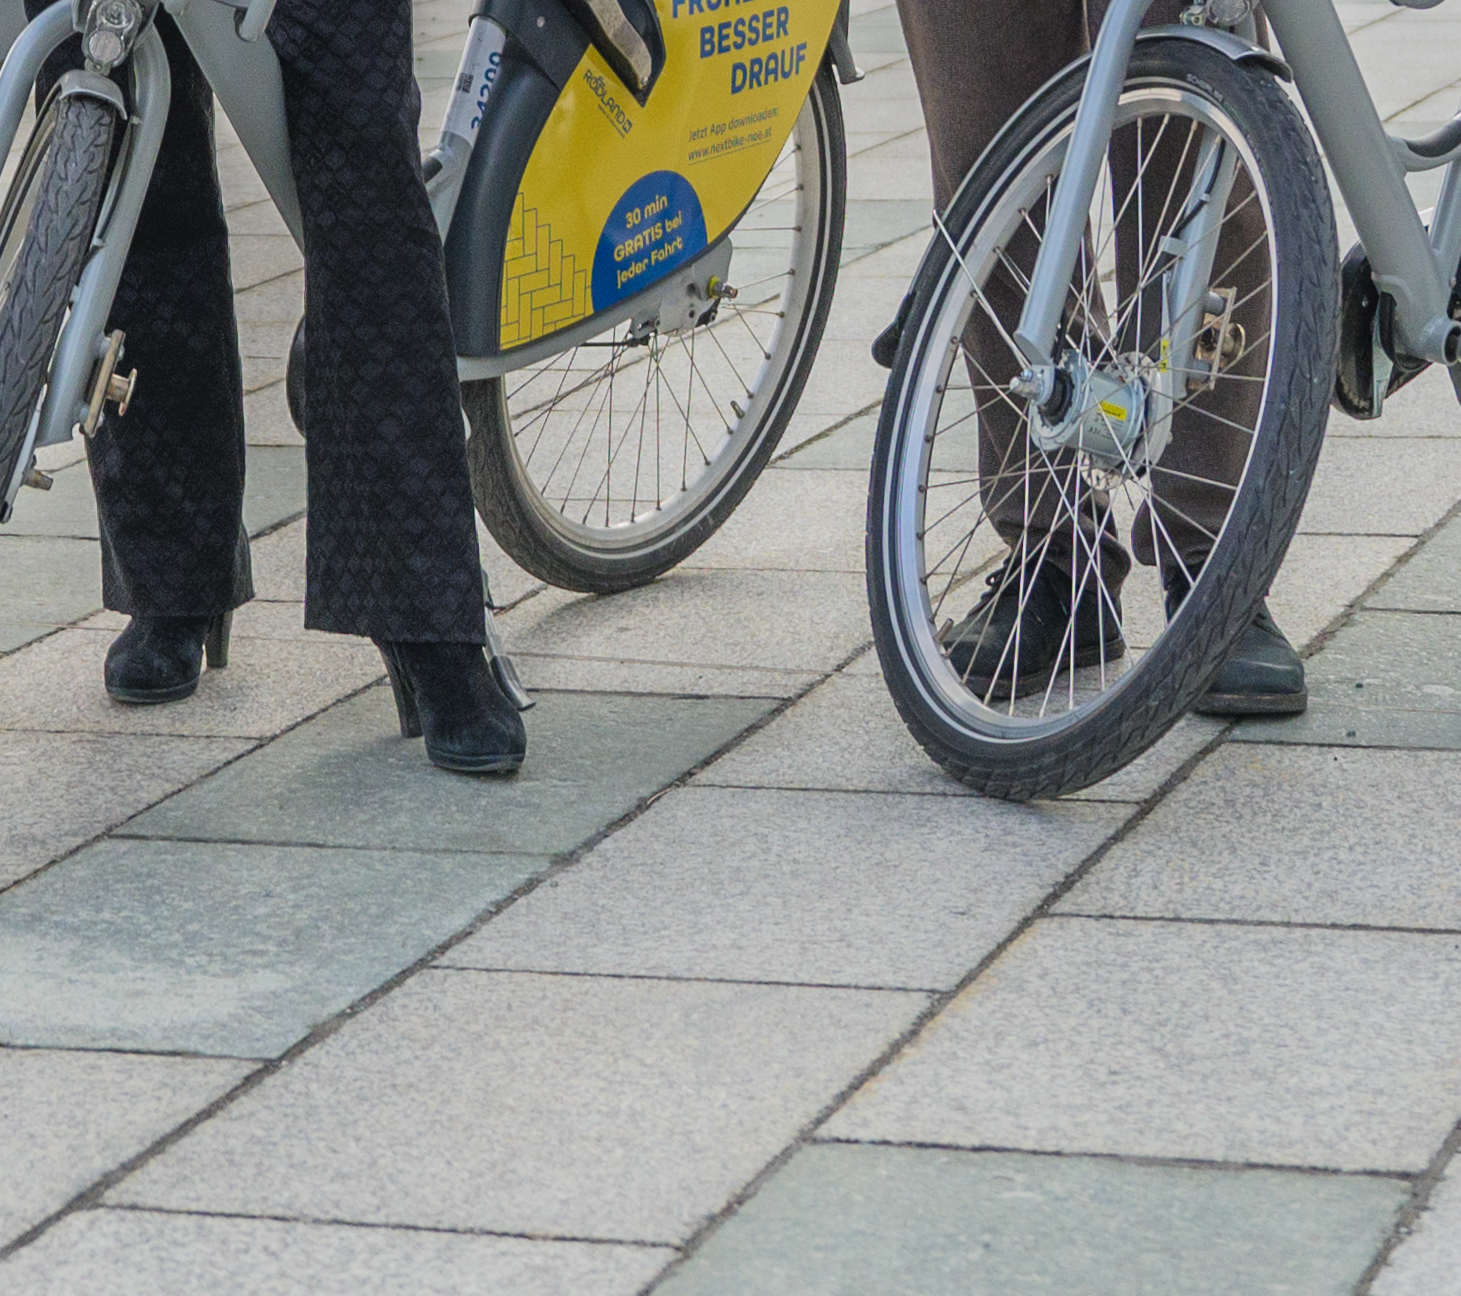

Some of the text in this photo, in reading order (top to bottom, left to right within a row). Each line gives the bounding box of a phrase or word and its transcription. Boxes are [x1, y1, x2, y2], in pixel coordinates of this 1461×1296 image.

[700, 6, 789, 59] BESSER
[730, 41, 808, 95] DRAUF
[688, 107, 778, 142] Jetzt App downloaden:
[688, 126, 772, 161] www.nextbike-noe.at
[613, 210, 682, 262] GRATIS bei
[625, 194, 668, 228] 30 min
[617, 236, 683, 289] jeder Fahrt
